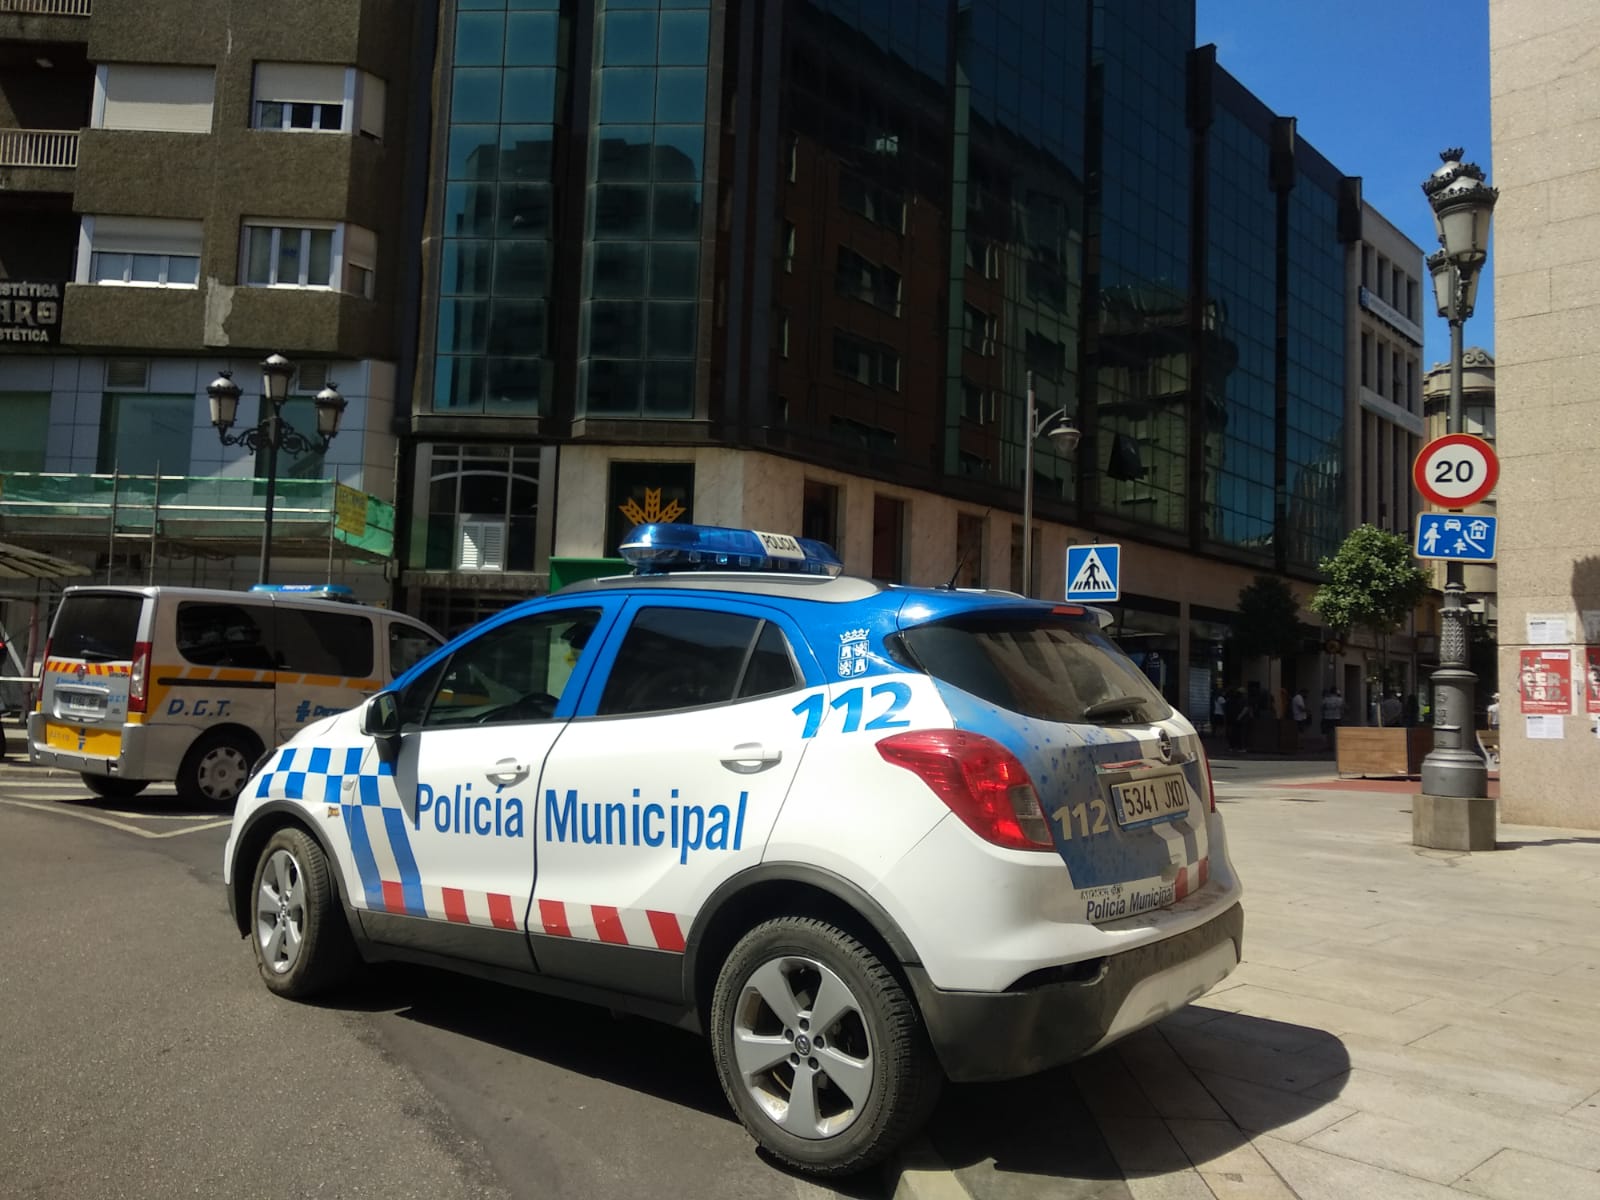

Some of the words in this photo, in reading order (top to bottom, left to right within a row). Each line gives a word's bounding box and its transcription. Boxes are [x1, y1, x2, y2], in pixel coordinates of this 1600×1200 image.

[0, 281, 59, 298] STÉTICA
[1435, 460, 1474, 483] 20
[167, 700, 231, 716] D.G.T.
[792, 682, 912, 739] 112
[1122, 784, 1159, 817] 5341
[1164, 780, 1184, 809] JXD
[414, 783, 524, 838] Policía
[545, 788, 749, 865] Municipal
[1052, 800, 1109, 840] 112
[1086, 894, 1126, 921] Policía
